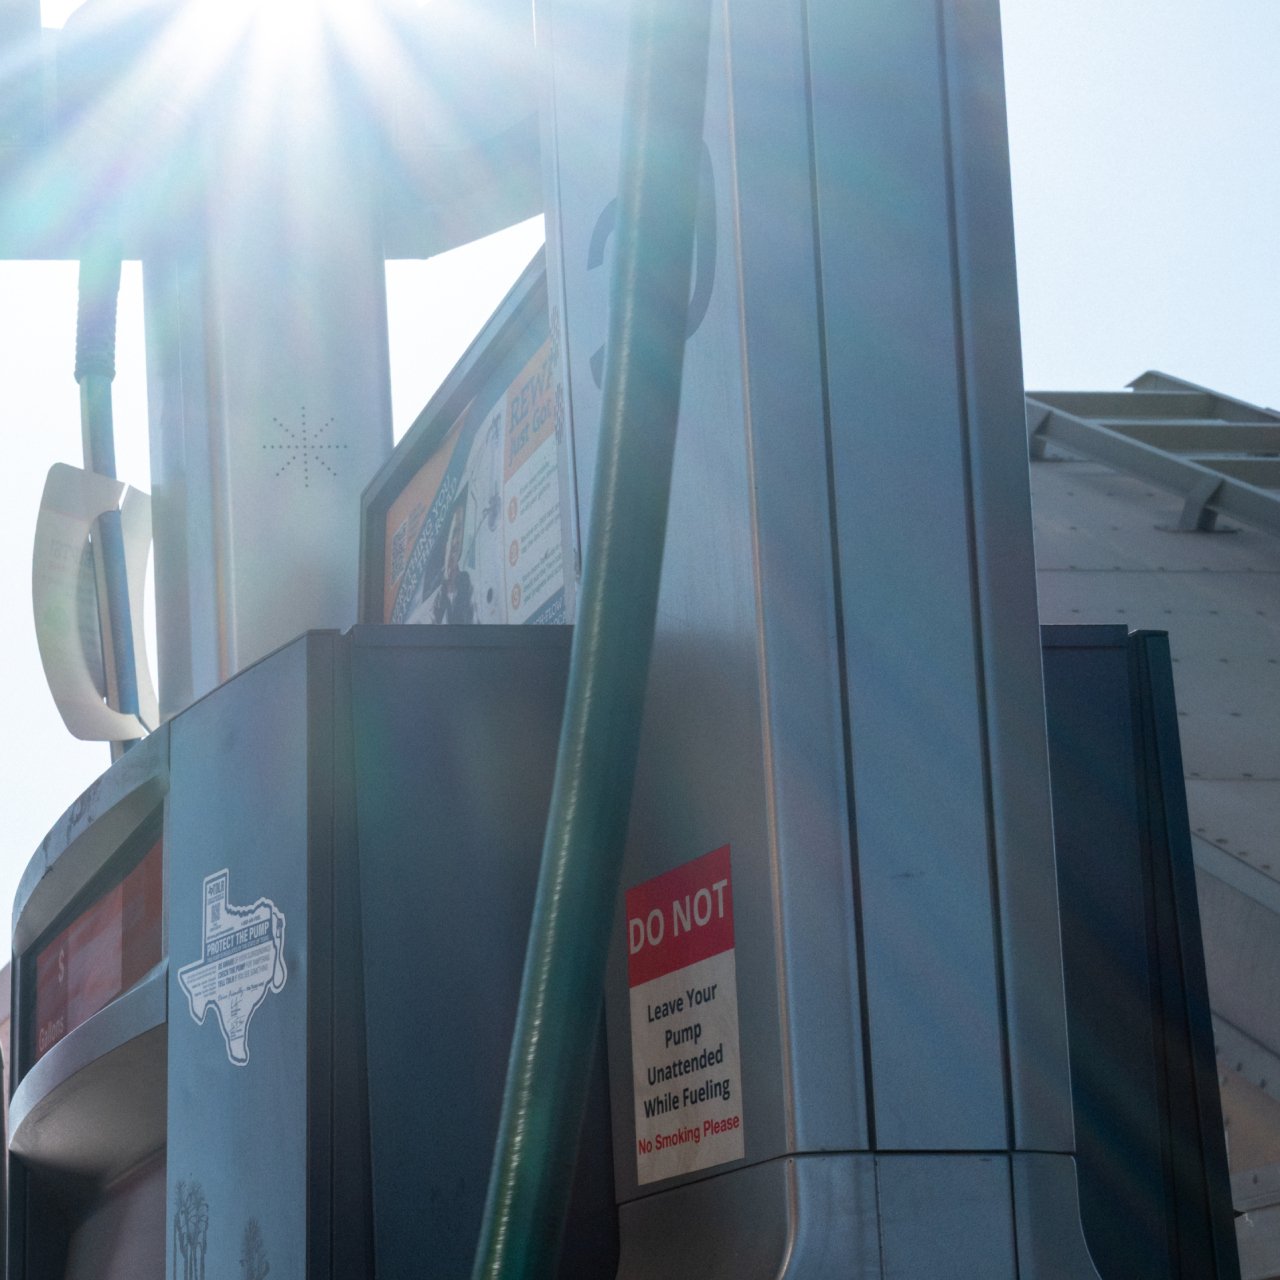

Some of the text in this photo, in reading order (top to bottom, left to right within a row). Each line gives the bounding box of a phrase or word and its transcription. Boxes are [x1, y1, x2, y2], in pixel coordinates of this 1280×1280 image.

[432, 475, 450, 517] YOU
[629, 878, 728, 955] DO NOT
[207, 935, 234, 956] PROTECT
[236, 929, 249, 944] THE
[249, 921, 270, 940] PUMP
[648, 982, 718, 1023] Leave Your
[38, 1015, 65, 1052] Gallons
[665, 1022, 702, 1049] Pump
[647, 1043, 724, 1086] Unattended
[643, 1076, 731, 1118] While Fueling
[638, 1113, 740, 1155] No Smoking Please
